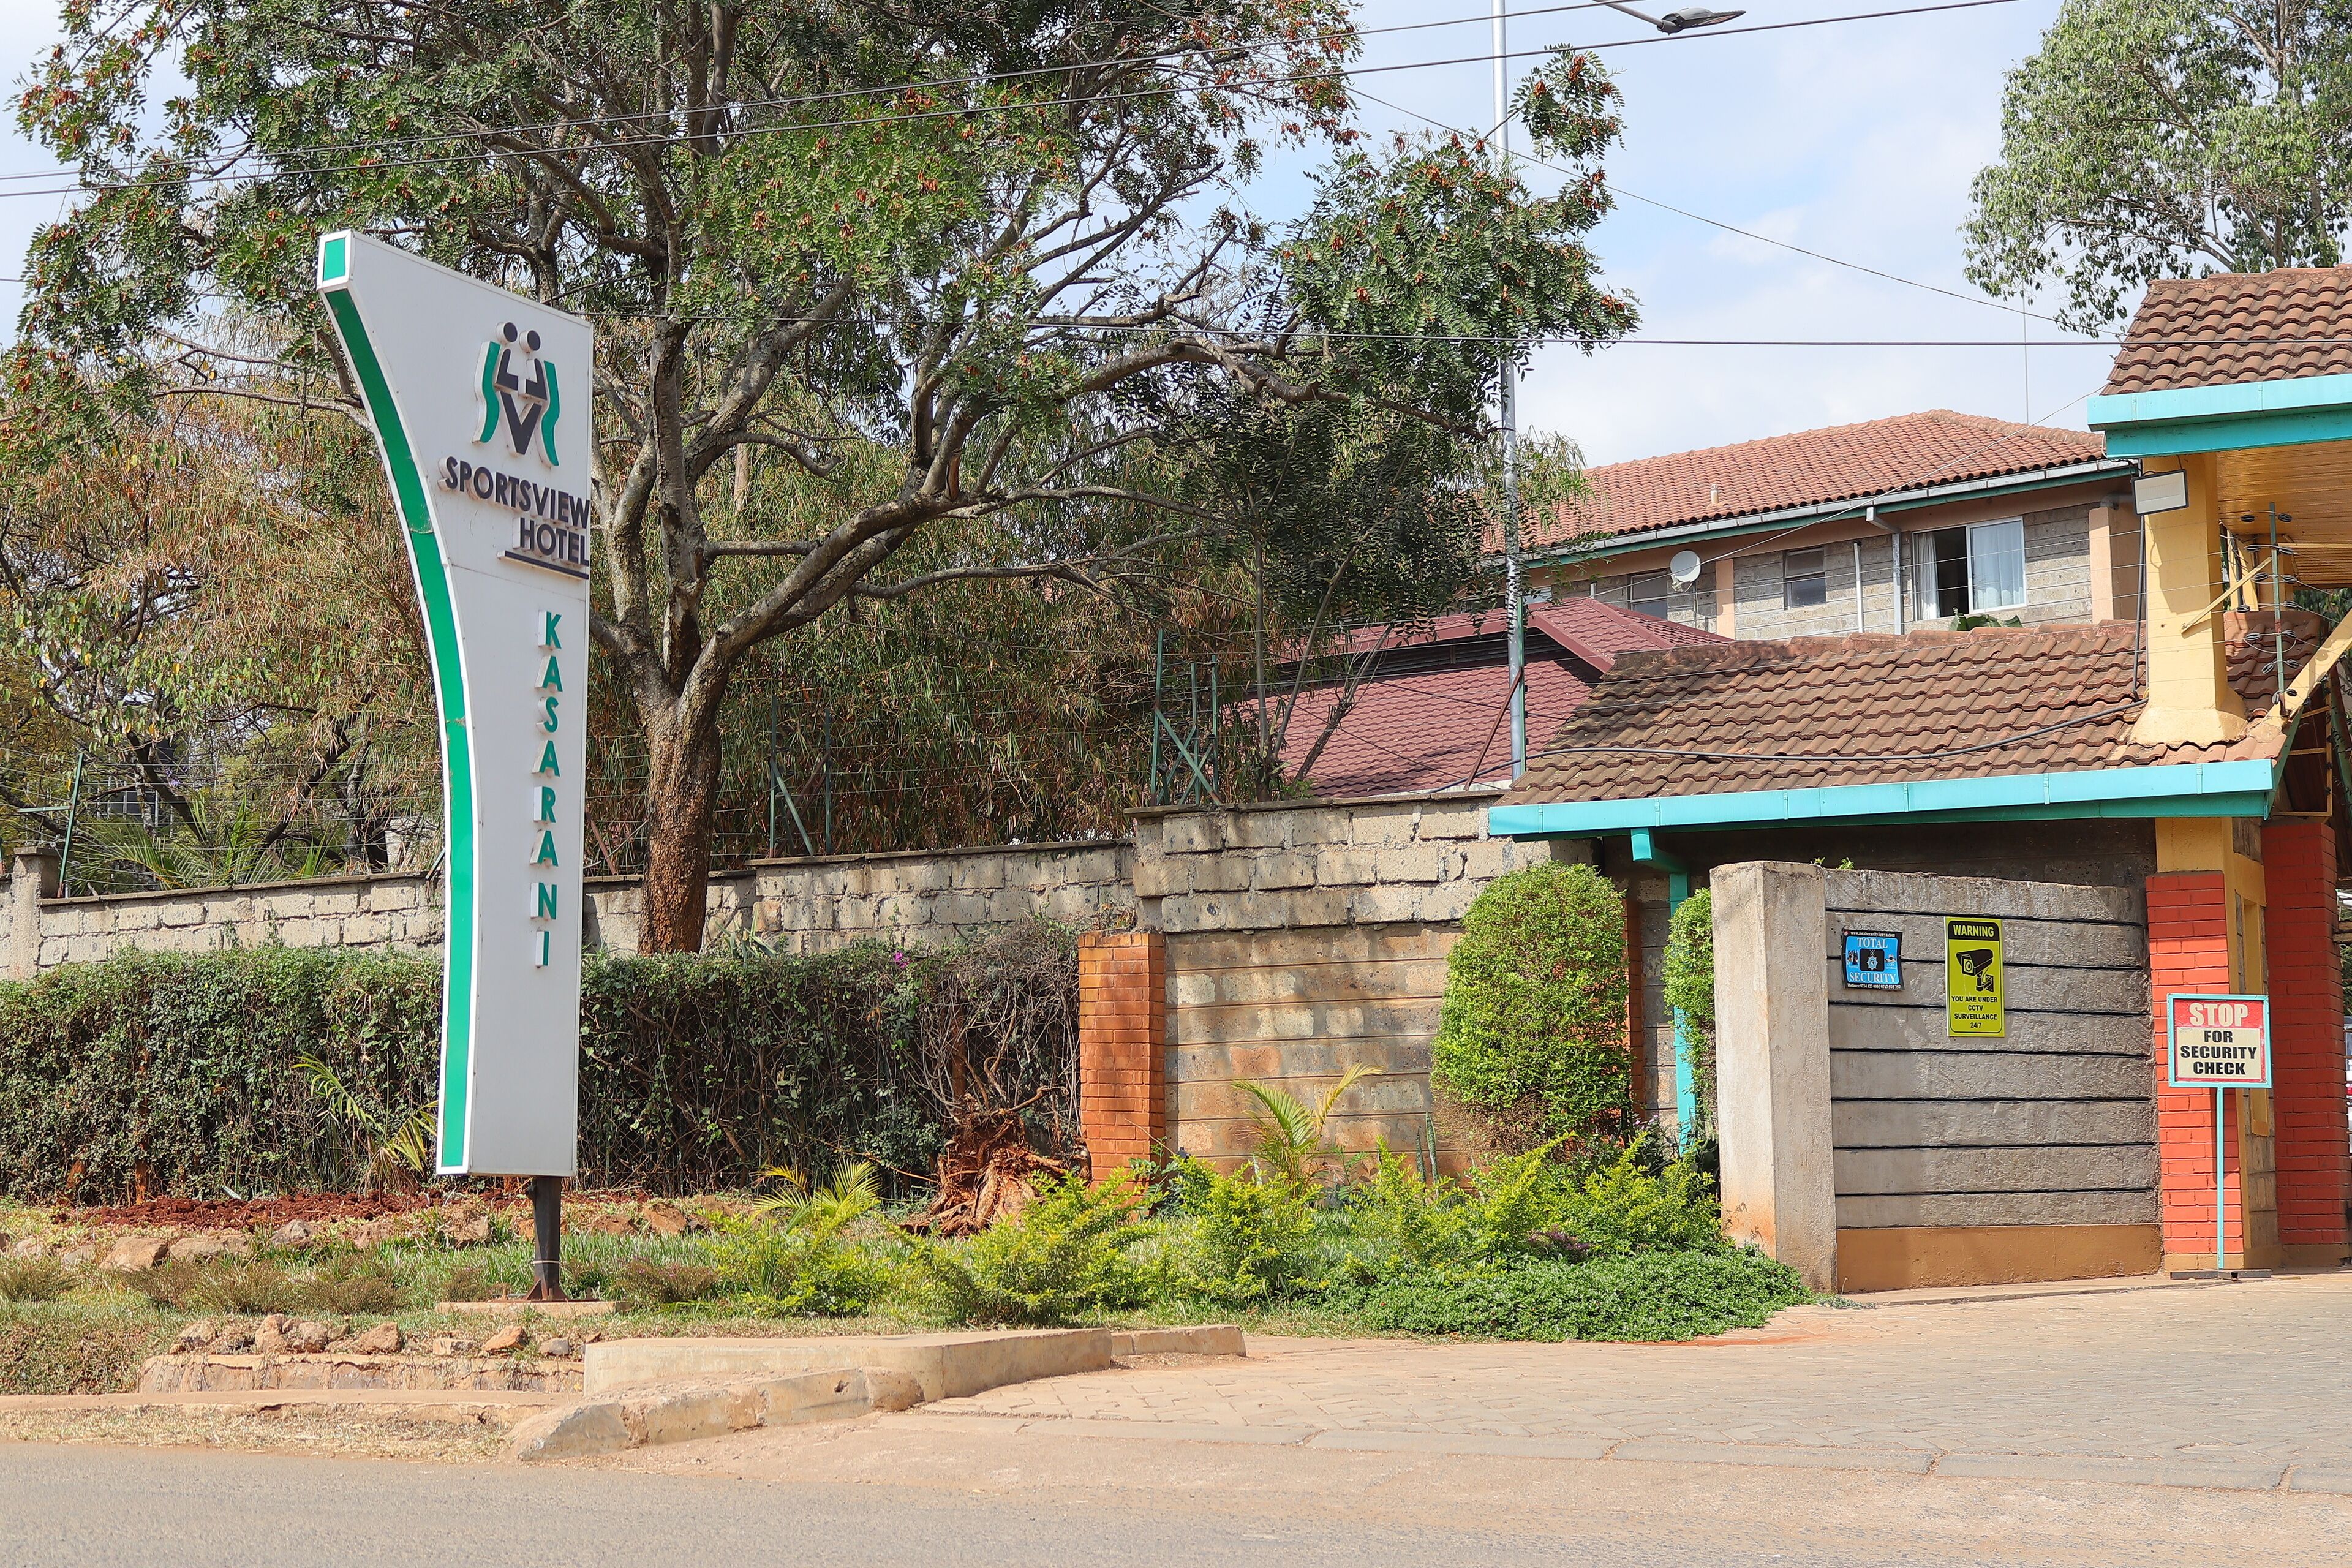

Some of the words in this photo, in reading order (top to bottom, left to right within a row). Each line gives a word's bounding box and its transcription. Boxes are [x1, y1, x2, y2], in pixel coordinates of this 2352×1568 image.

[443, 456, 590, 529] SPORTSVIEW
[518, 516, 590, 567] HOTEL
[533, 610, 563, 967] KASARANI
[1953, 924, 1994, 937] WARNING
[1857, 938, 1888, 948] TOTAL
[1850, 972, 1896, 982] SECURITY
[2188, 1003, 2249, 1027] STOP
[2204, 1030, 2233, 1043] FOR
[2180, 1046, 2257, 1060] SECURITY
[2193, 1061, 2246, 1075] CHECK
